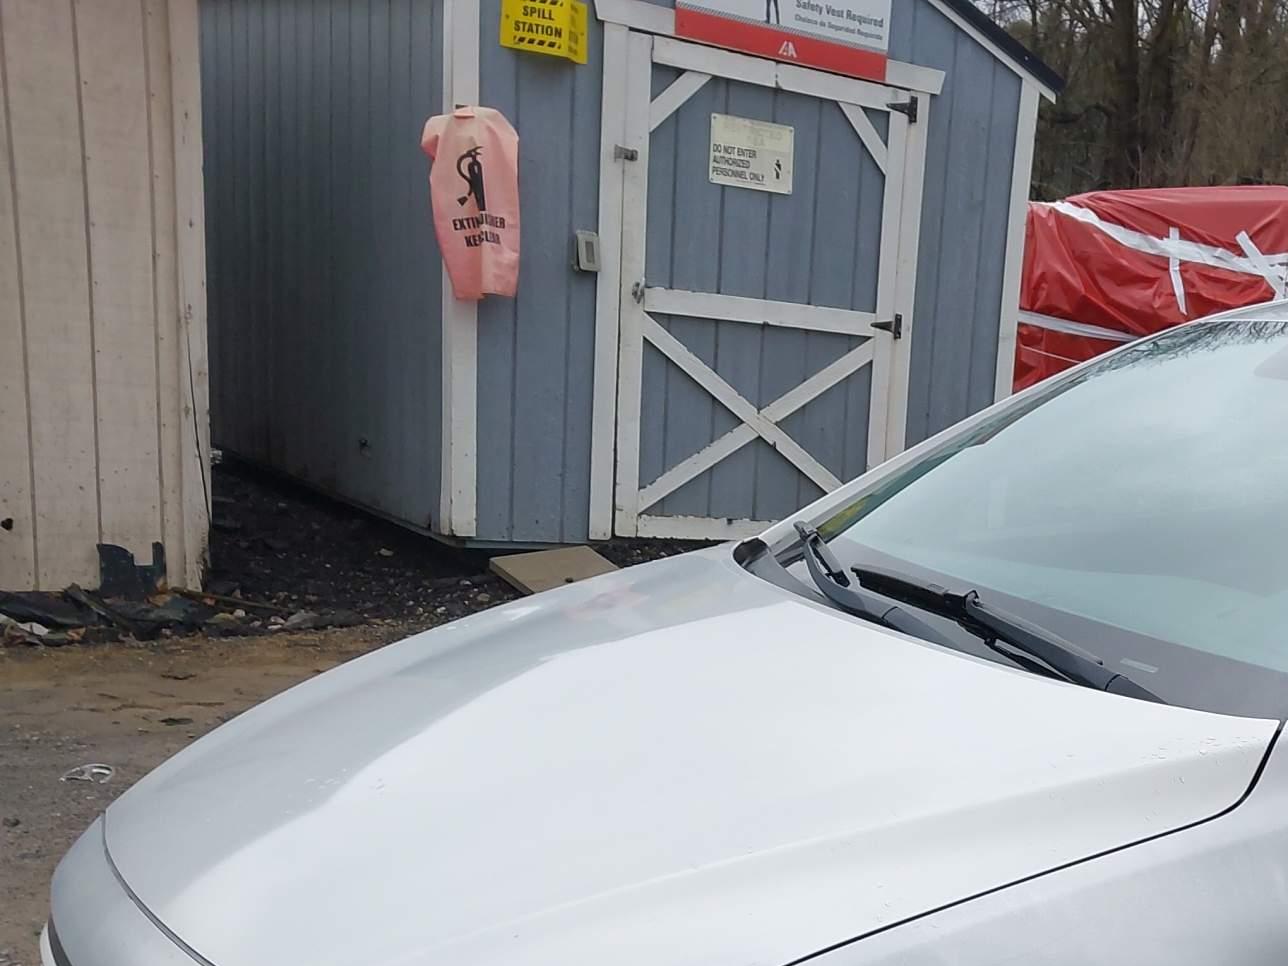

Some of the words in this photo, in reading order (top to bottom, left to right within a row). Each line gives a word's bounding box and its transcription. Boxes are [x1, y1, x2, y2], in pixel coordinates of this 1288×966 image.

[522, 5, 555, 21] SPILL
[795, 0, 823, 15] Safety
[825, 4, 844, 18] Vest
[846, 9, 884, 28] Required
[514, 20, 562, 38] STATION
[713, 144, 721, 153] DO
[724, 145, 735, 155] NOT
[737, 147, 757, 159] ENTER
[713, 155, 750, 169] AUTHORIZED
[712, 166, 748, 180] PERSONNEL
[749, 172, 764, 182] ONLY
